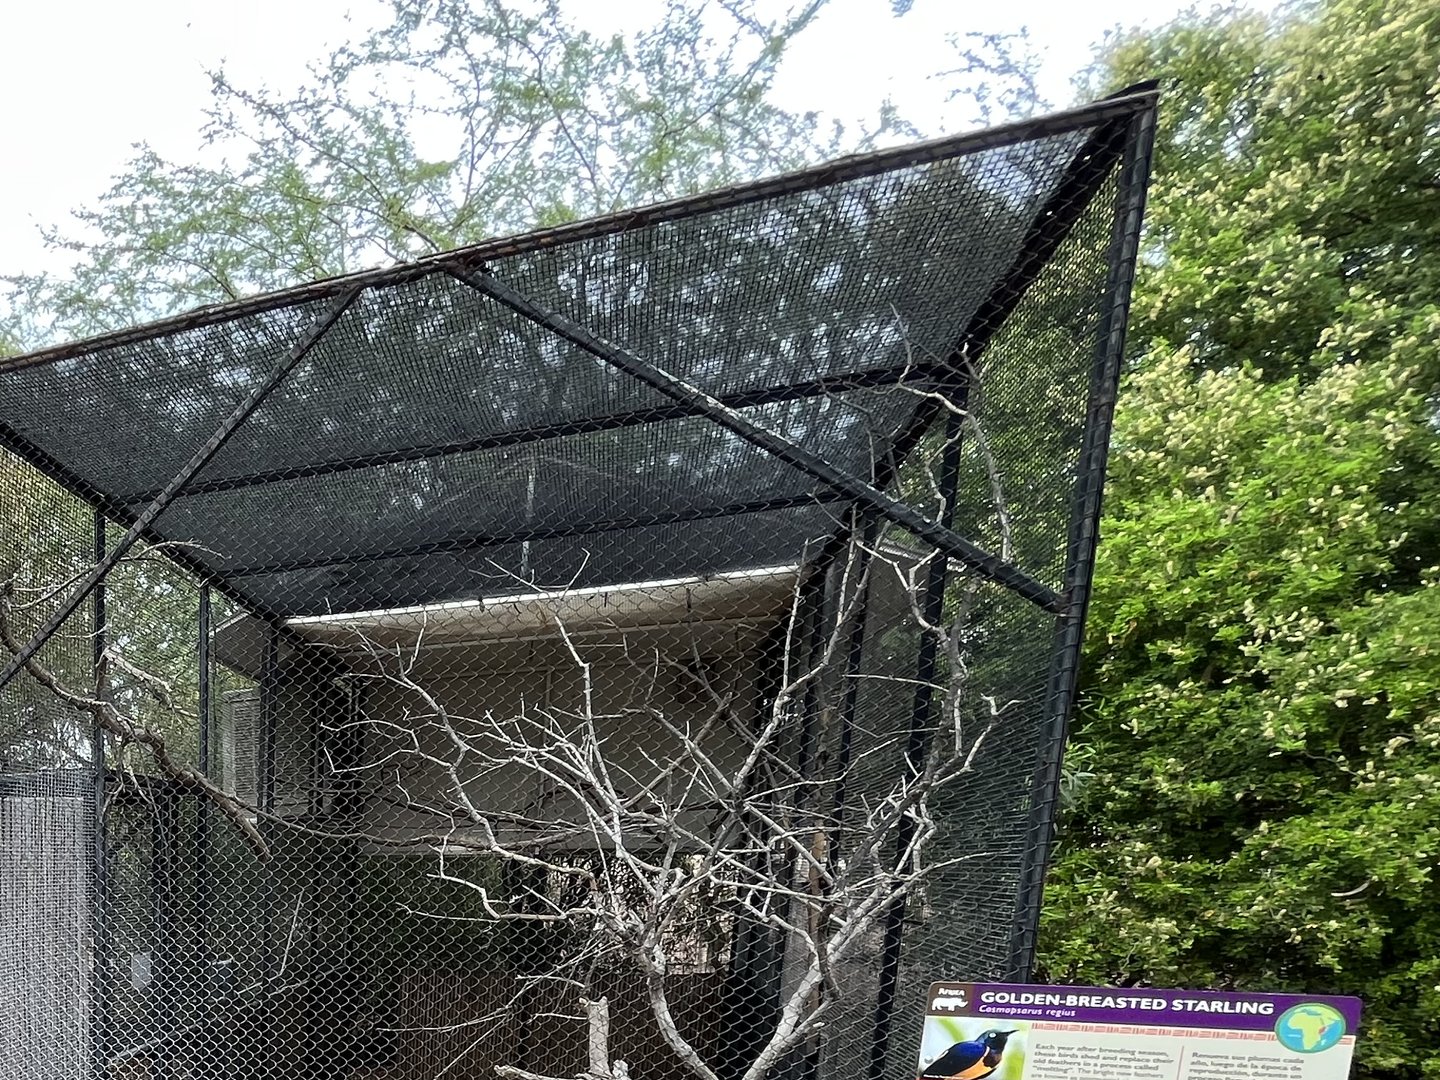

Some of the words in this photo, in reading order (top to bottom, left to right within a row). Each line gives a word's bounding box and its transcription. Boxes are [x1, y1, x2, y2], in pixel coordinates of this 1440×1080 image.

[979, 1004, 1042, 1015] Cosmopsarus
[1046, 1008, 1076, 1018] regius
[980, 991, 1167, 1010] GOLDEN-BREASTED
[1171, 999, 1274, 1015] STARLING
